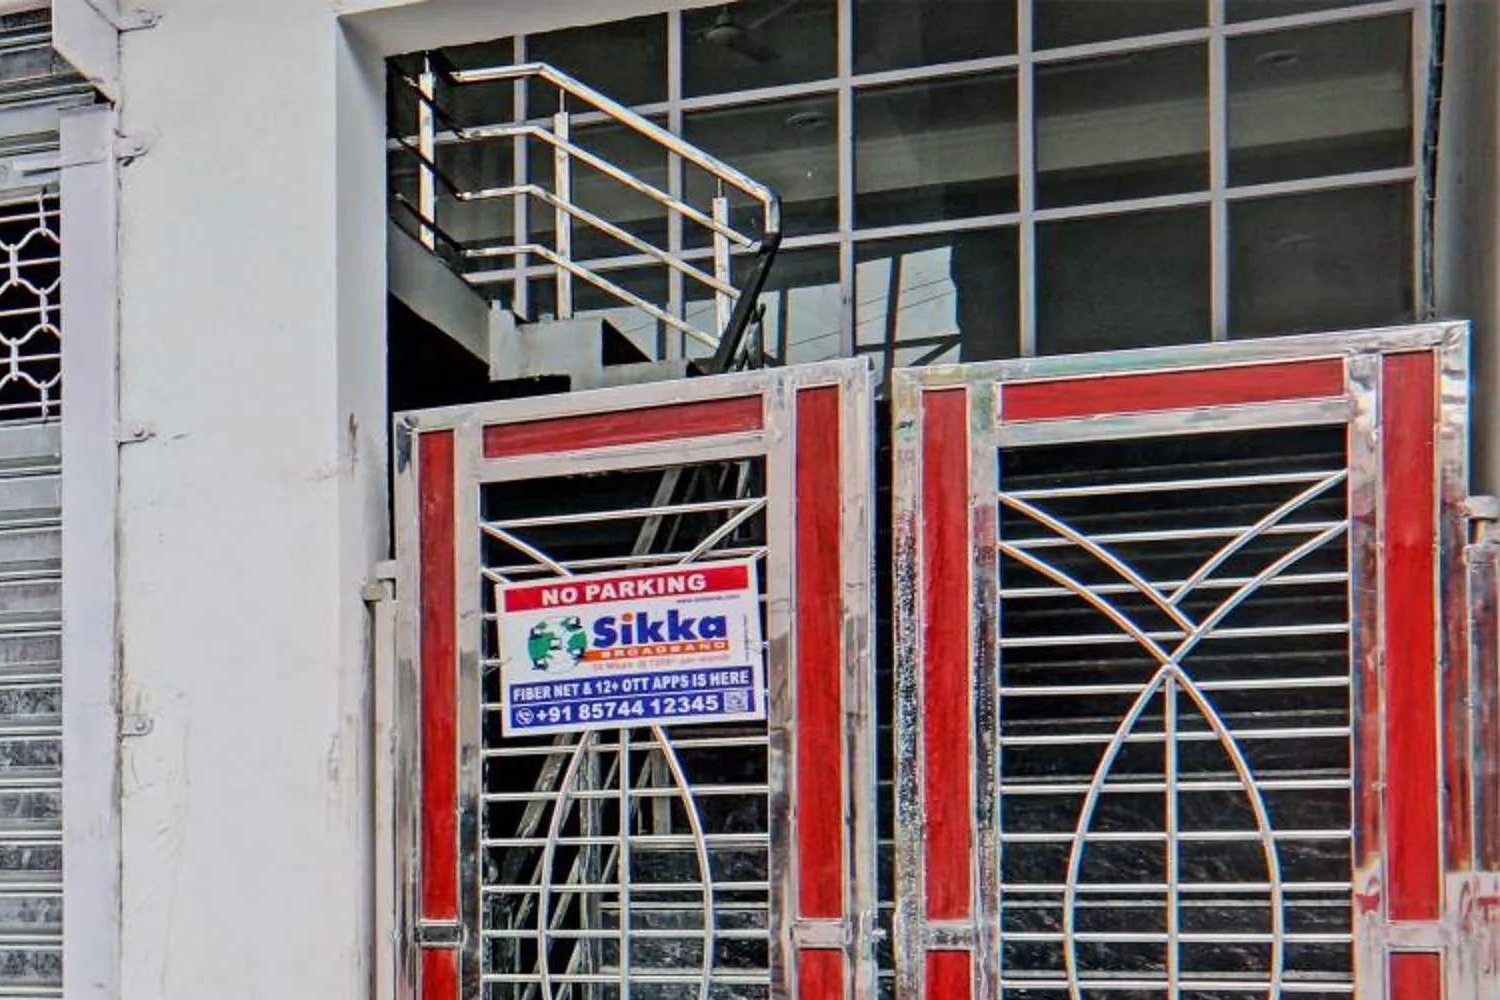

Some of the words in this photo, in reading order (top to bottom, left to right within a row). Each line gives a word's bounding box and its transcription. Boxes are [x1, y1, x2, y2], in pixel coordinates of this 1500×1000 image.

[541, 587, 578, 606] NO
[585, 574, 707, 601] PARKING
[593, 609, 727, 648] Sikka
[601, 641, 725, 659] BROADBAND
[513, 685, 551, 702] FIBER
[553, 683, 580, 698] NET
[582, 681, 593, 695] &
[622, 677, 649, 693] OTT
[652, 674, 689, 691] APPS
[692, 672, 707, 688] IS
[709, 670, 749, 687] HERE
[536, 705, 572, 723] +91
[578, 700, 645, 720] 85744
[650, 694, 719, 715] 12345
